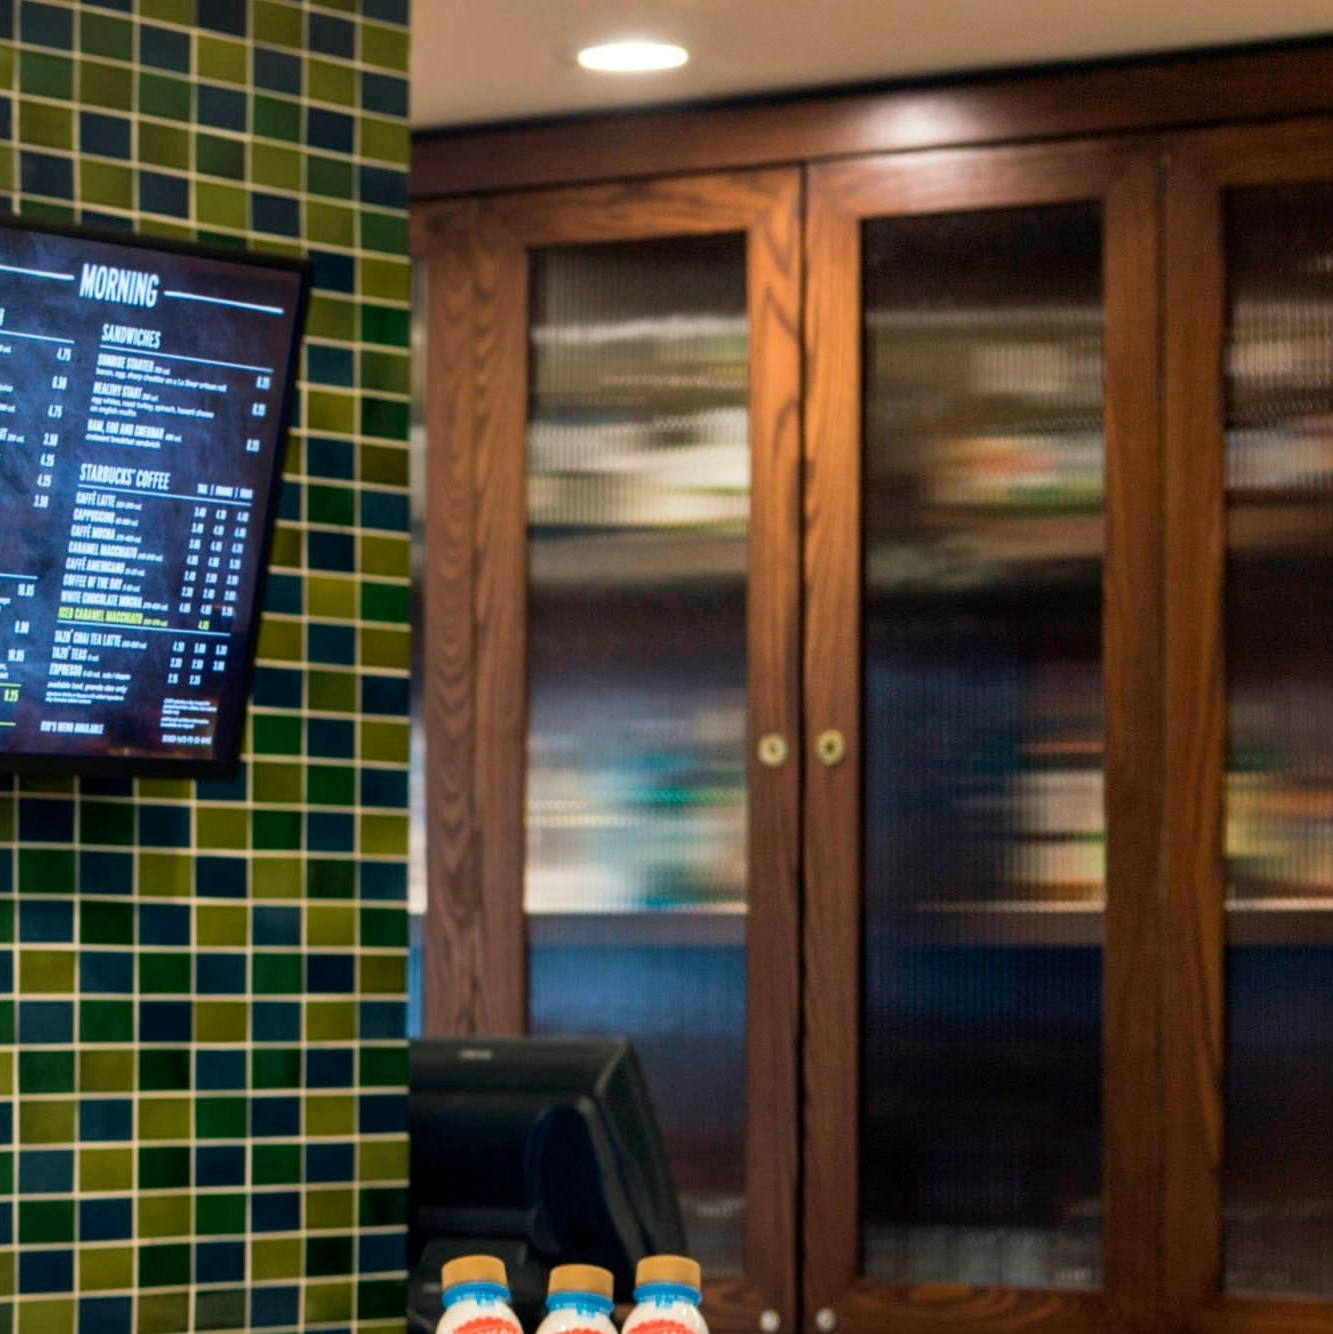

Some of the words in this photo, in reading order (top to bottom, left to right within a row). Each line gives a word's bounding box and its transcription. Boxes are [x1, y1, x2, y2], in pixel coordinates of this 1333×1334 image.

[79, 263, 160, 308] MORNING
[101, 323, 161, 349] SANDWICHES
[136, 470, 171, 491] COFFEE
